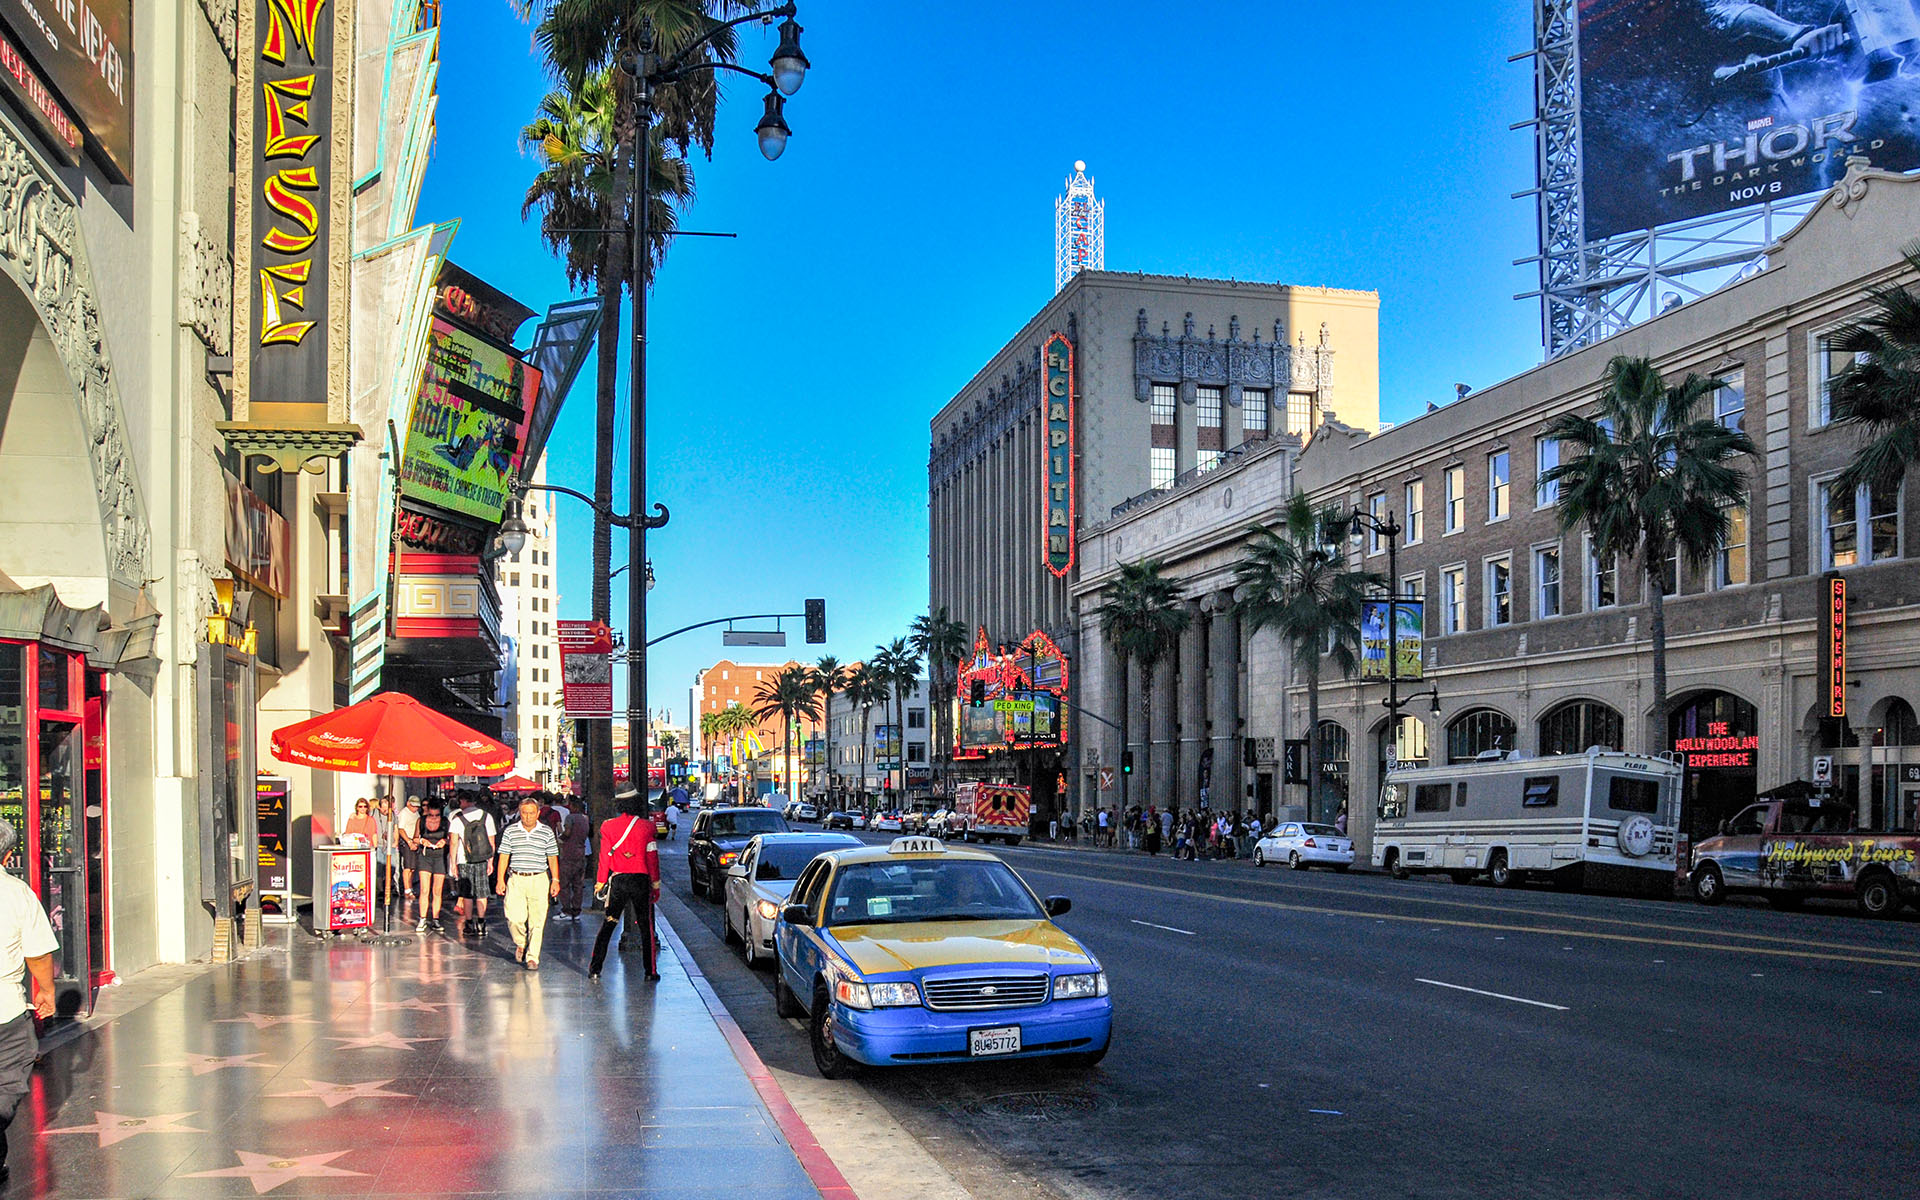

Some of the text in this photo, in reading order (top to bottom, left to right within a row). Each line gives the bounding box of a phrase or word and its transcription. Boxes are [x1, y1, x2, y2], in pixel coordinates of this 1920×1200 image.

[1748, 116, 1774, 131] MARVEL
[1667, 109, 1859, 182] THOR
[1659, 138, 1885, 199] THE DARK WORLD
[1729, 181, 1782, 202] NOV 8
[1048, 352, 1069, 372] EL
[1048, 375, 1069, 554] CAPITAN
[1834, 581, 1843, 714] SOUVENIRS
[1707, 721, 1728, 735] THE
[1286, 745, 1294, 778] ZARA
[1322, 763, 1338, 772] ZARA
[1688, 753, 1749, 767] EXPERIENCE
[902, 840, 935, 852] TAXI
[1768, 840, 1915, 867] Hollywood Tours
